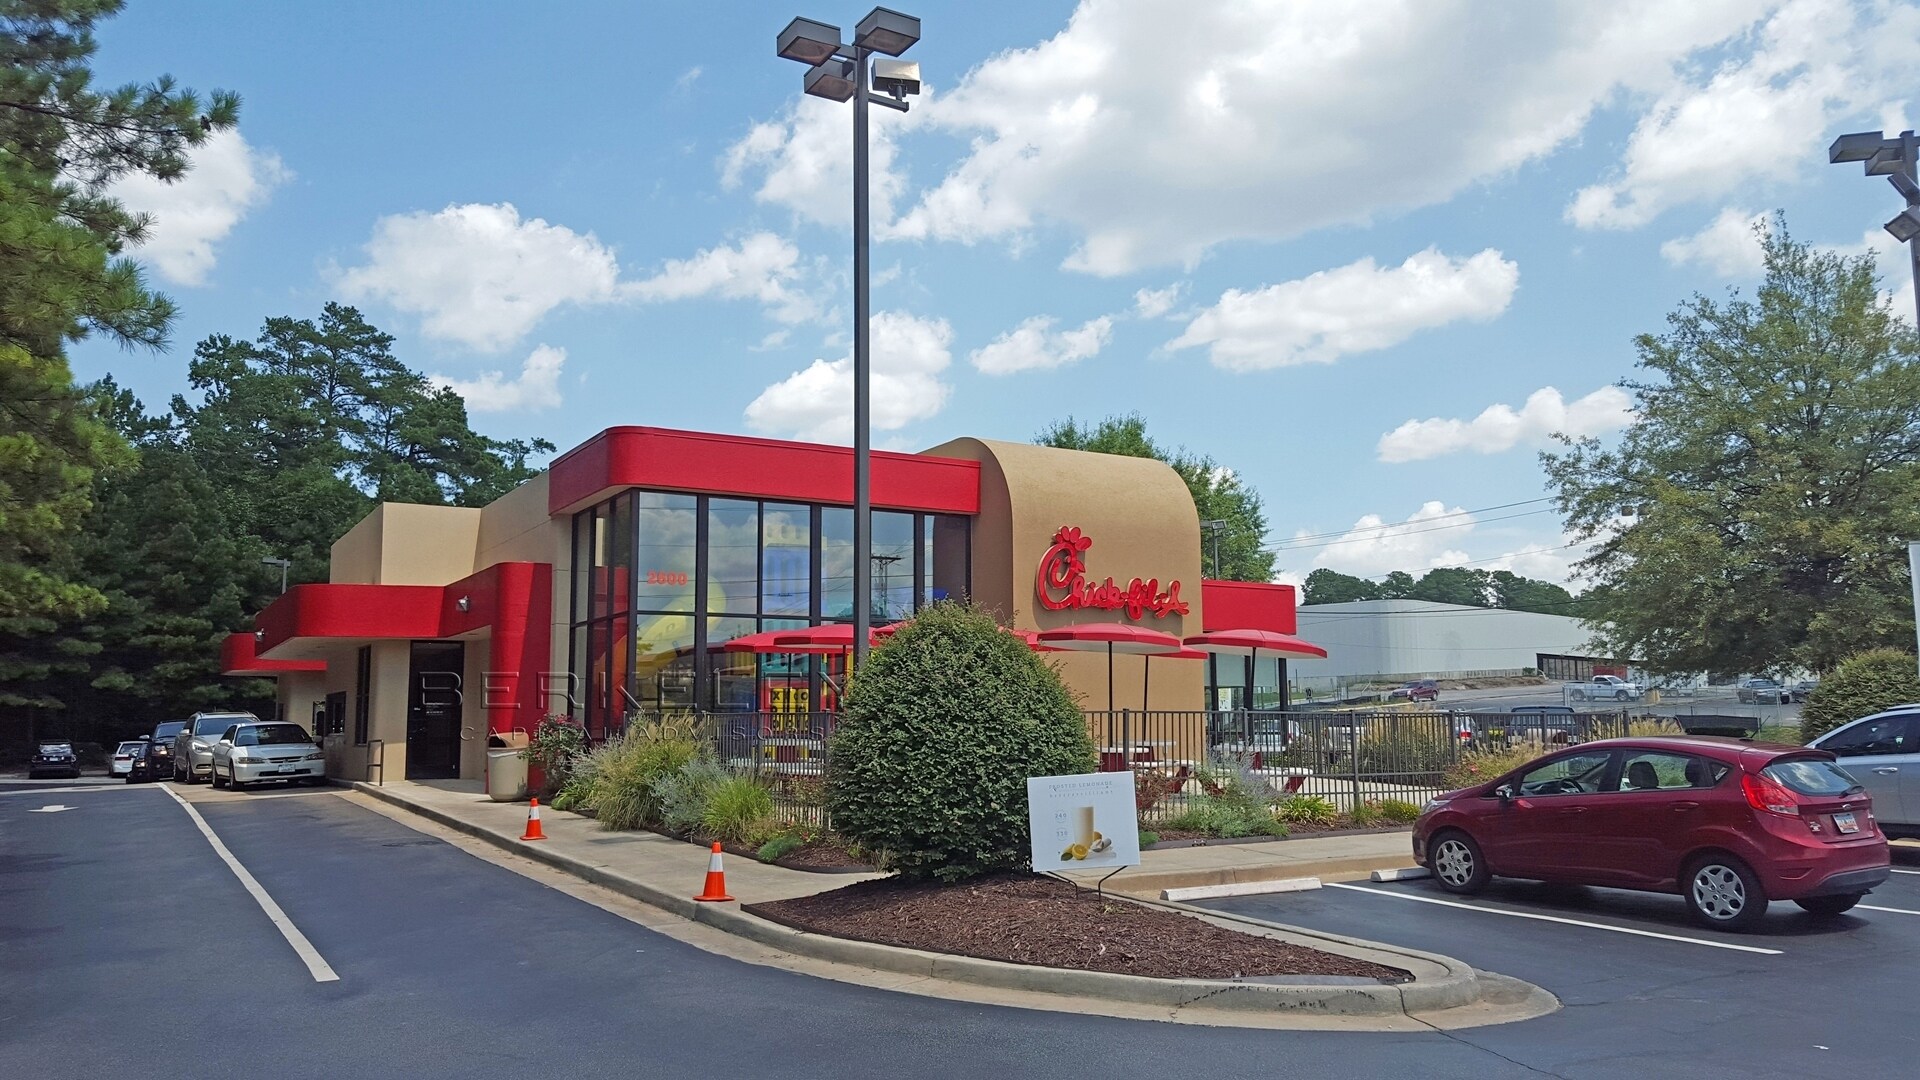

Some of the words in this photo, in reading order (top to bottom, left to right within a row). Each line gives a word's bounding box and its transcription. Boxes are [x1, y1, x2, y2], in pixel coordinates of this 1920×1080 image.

[647, 569, 688, 586] 2600
[1037, 526, 1190, 621] Chick-fil-A
[1078, 780, 1112, 788] LEMONADE
